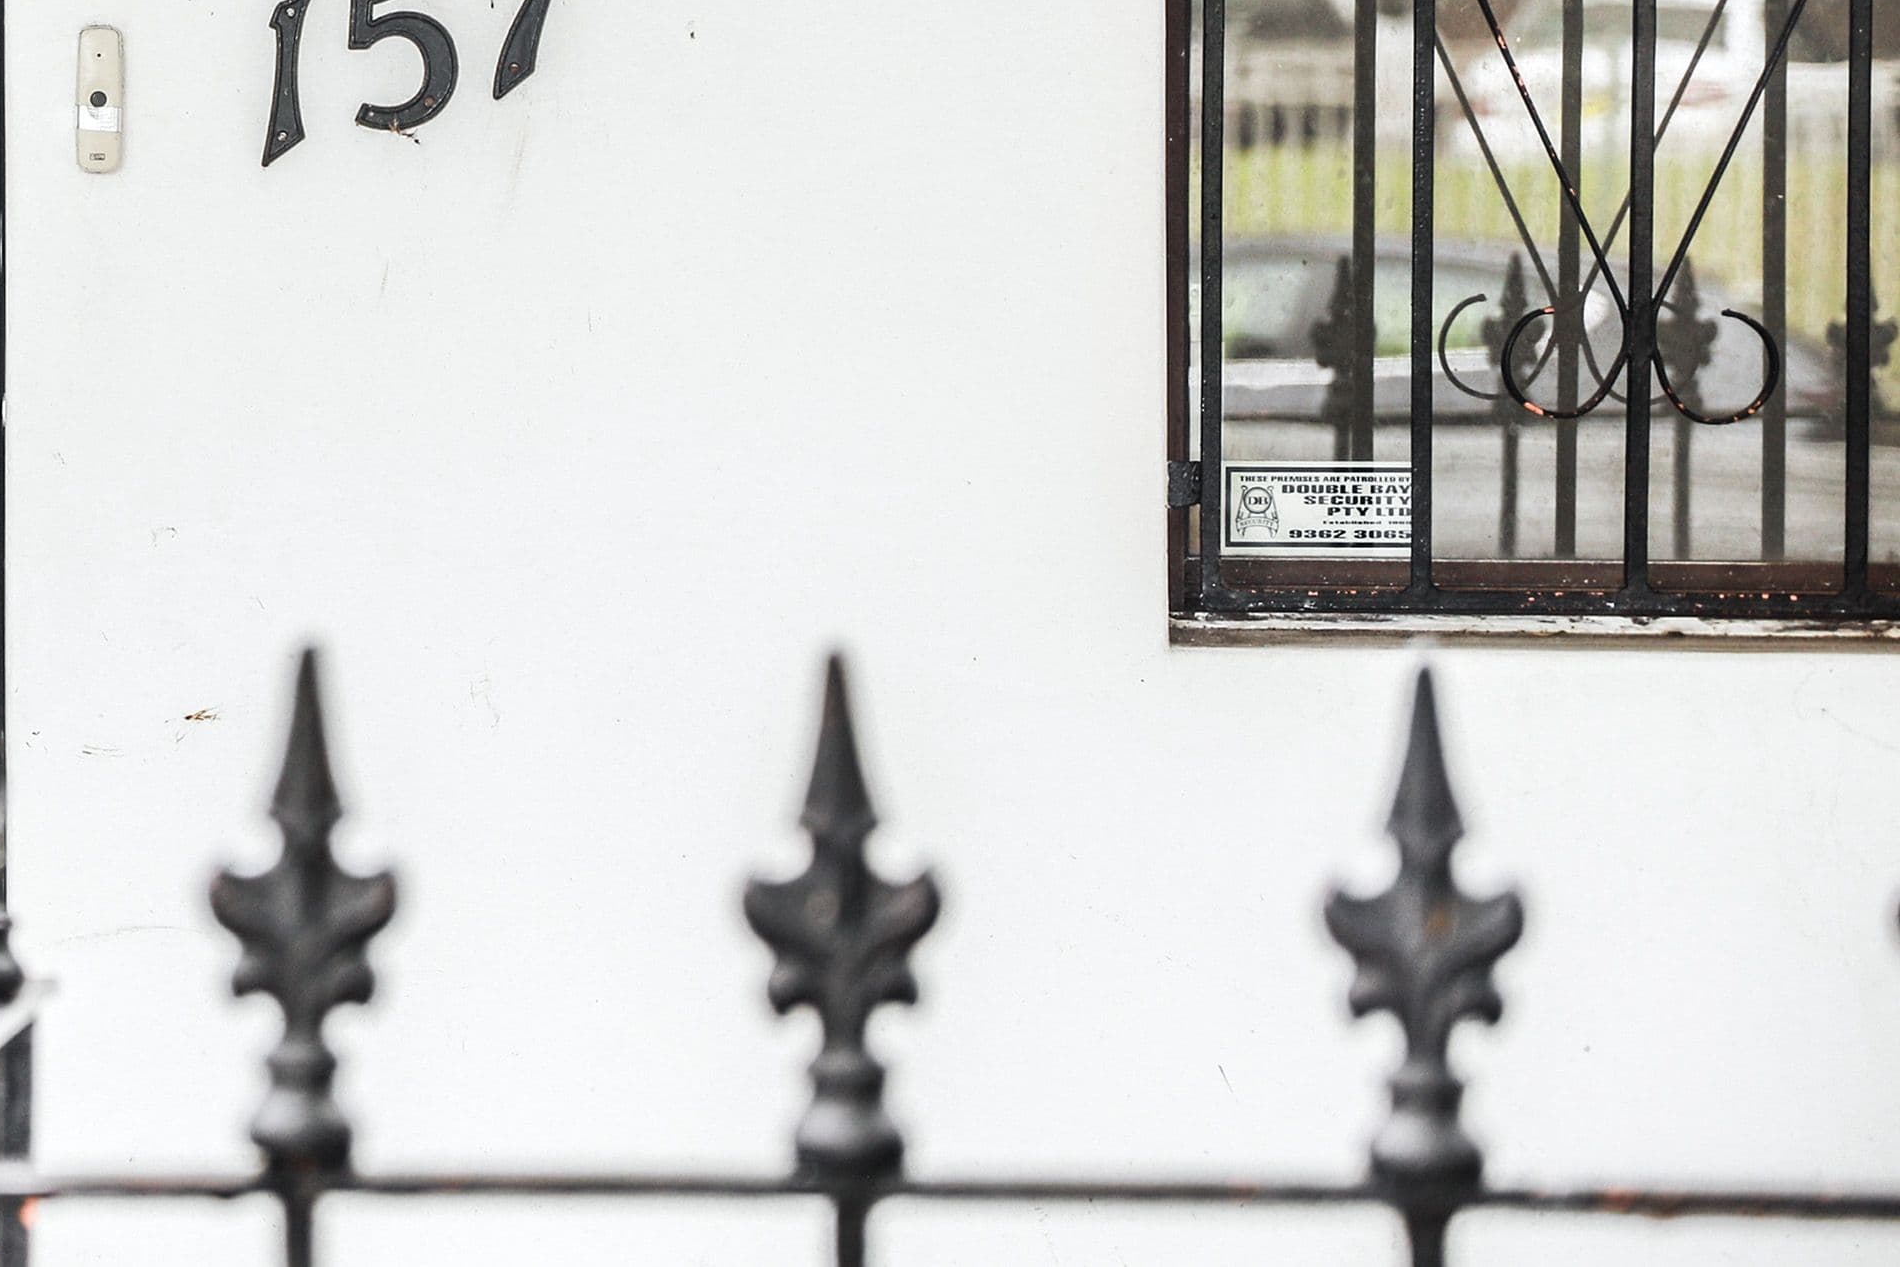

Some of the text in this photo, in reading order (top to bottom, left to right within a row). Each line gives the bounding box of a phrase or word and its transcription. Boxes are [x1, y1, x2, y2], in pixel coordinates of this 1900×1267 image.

[1282, 484, 1411, 494] DOUBLE BAY
[1304, 496, 1411, 505] SECURITY
[1327, 507, 1411, 516] PTY LTD
[1289, 529, 1411, 539] 9362 3065
